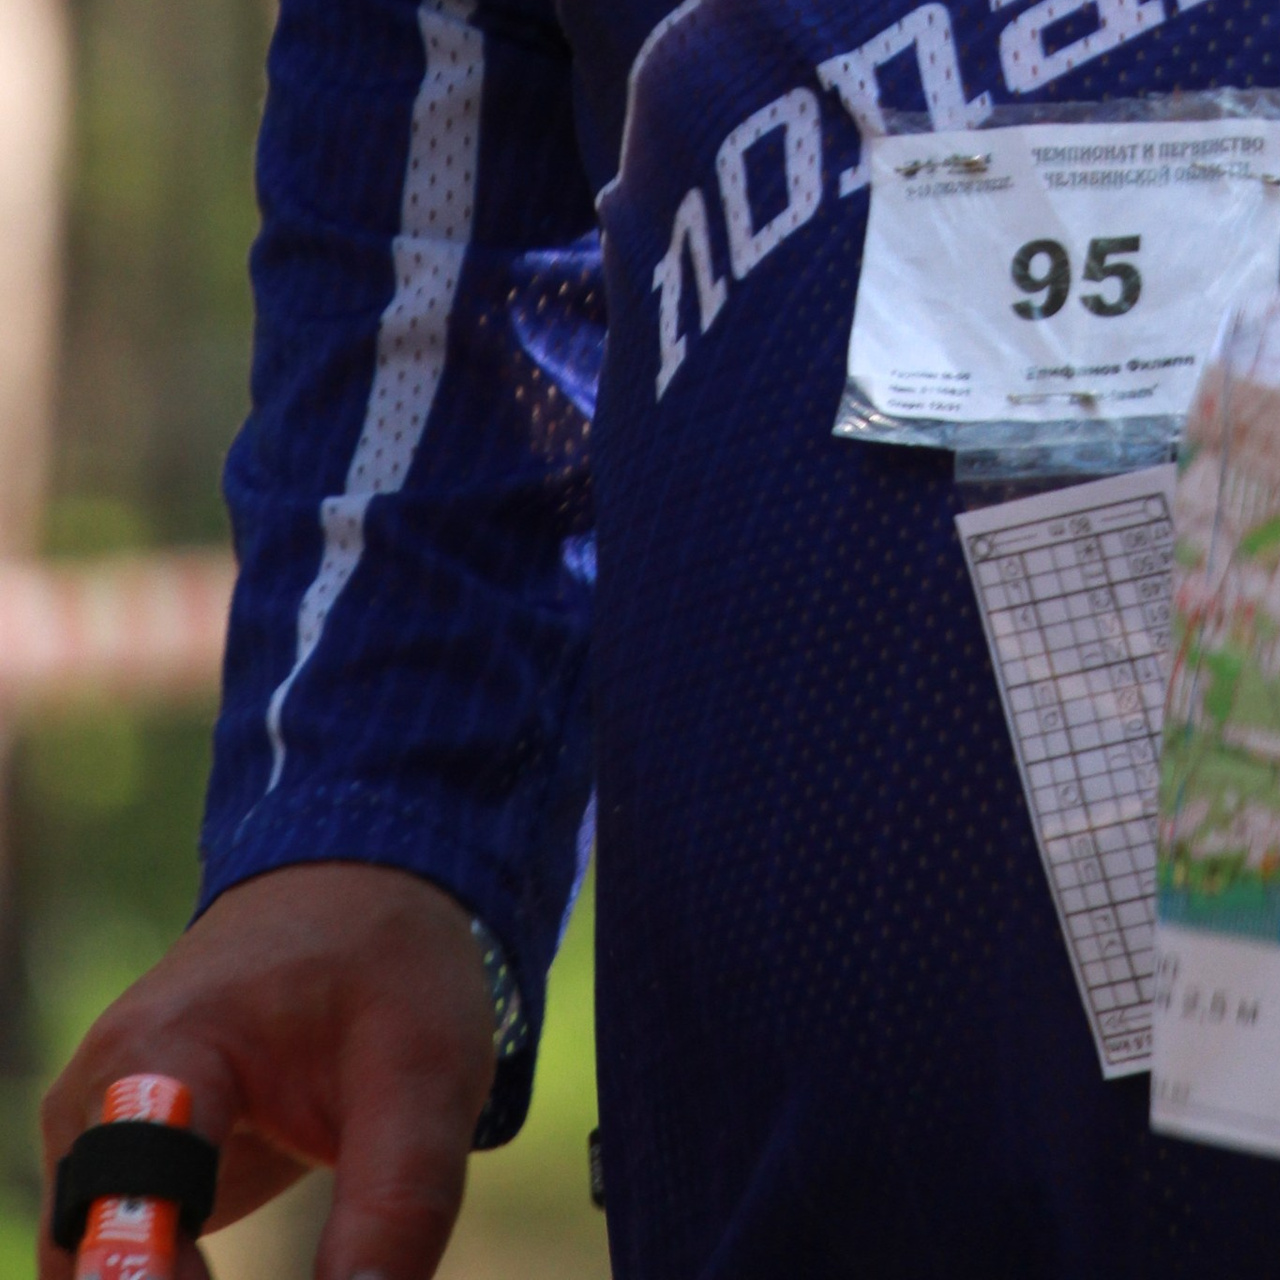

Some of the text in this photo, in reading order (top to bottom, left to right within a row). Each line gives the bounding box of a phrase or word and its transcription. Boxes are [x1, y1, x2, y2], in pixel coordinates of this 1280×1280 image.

[1031, 136, 1266, 166] ЧЕМПИОНАТ И ПЕРВЕНСТВО
[1043, 164, 1170, 190] ЧЕЛЯБИНСКОЙ
[1010, 234, 1143, 321] 95
